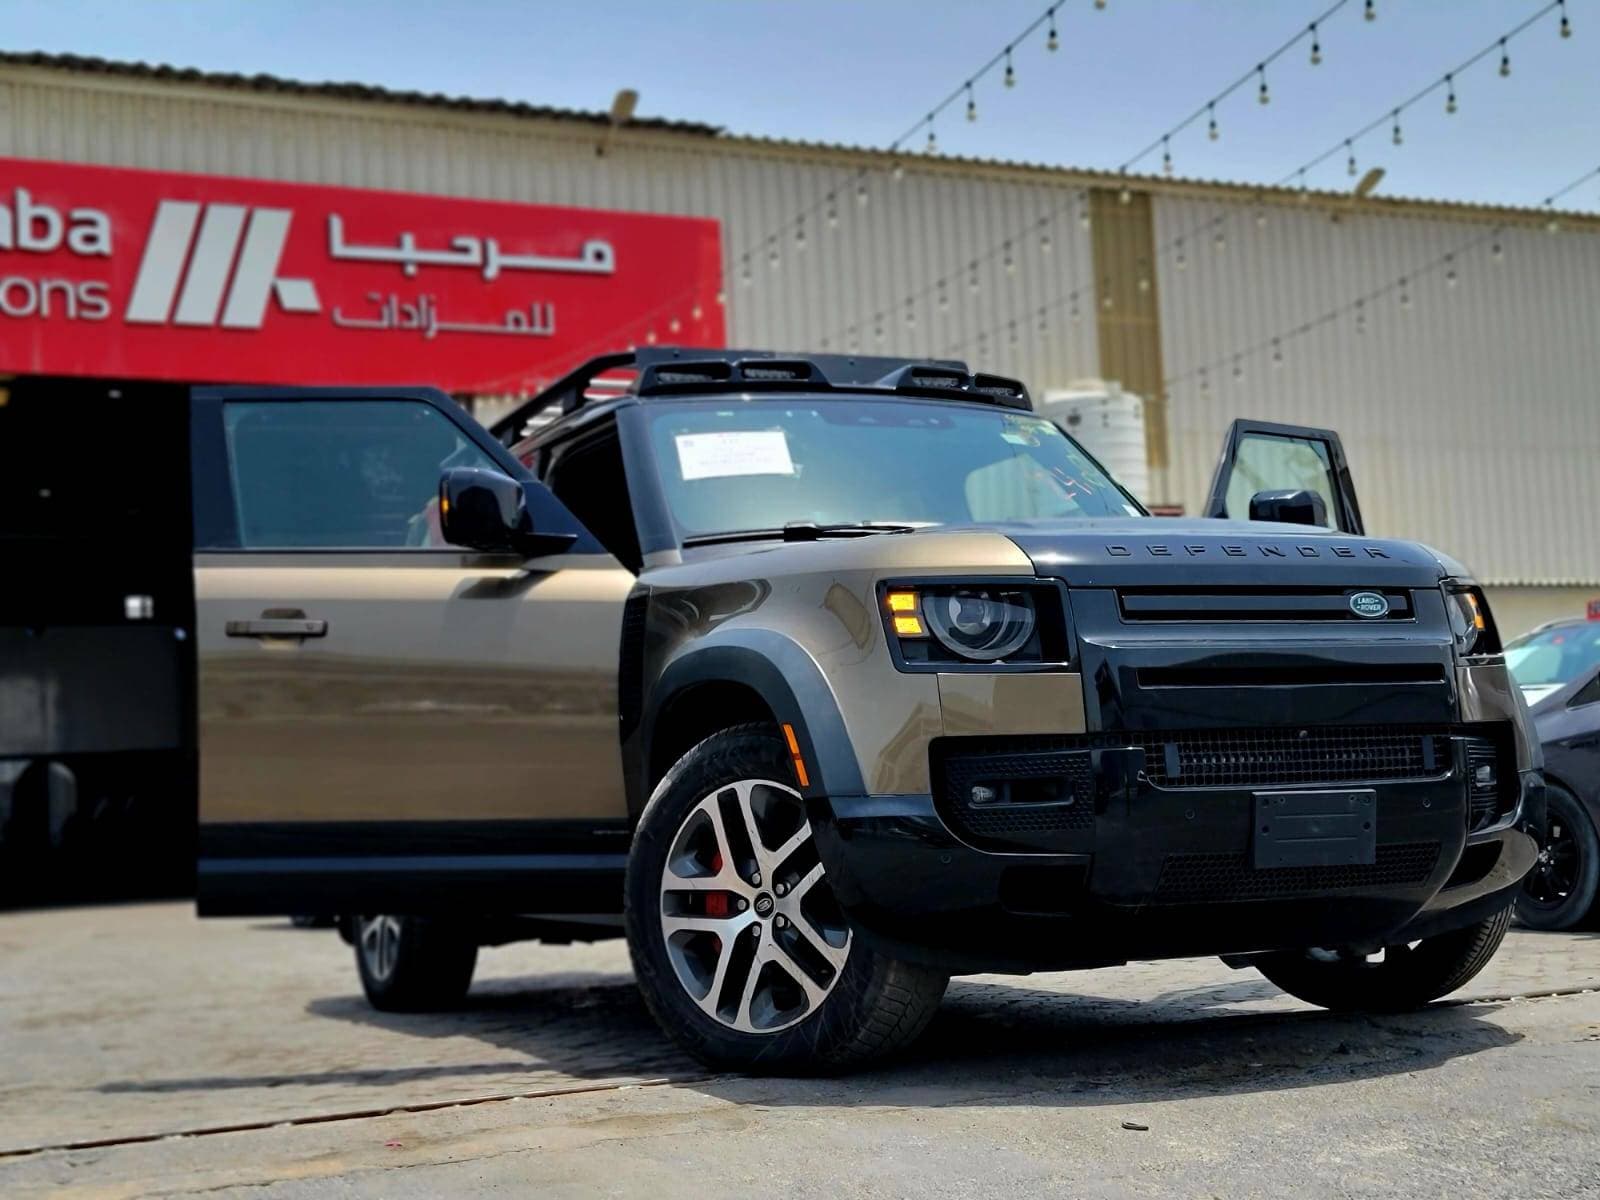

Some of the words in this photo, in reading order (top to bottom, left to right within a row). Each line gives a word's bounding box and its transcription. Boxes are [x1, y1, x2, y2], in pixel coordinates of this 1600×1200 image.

[329, 212, 615, 280] مرحبا
[333, 291, 555, 339] للمزادات
[1105, 544, 1391, 560] DEFENDER
